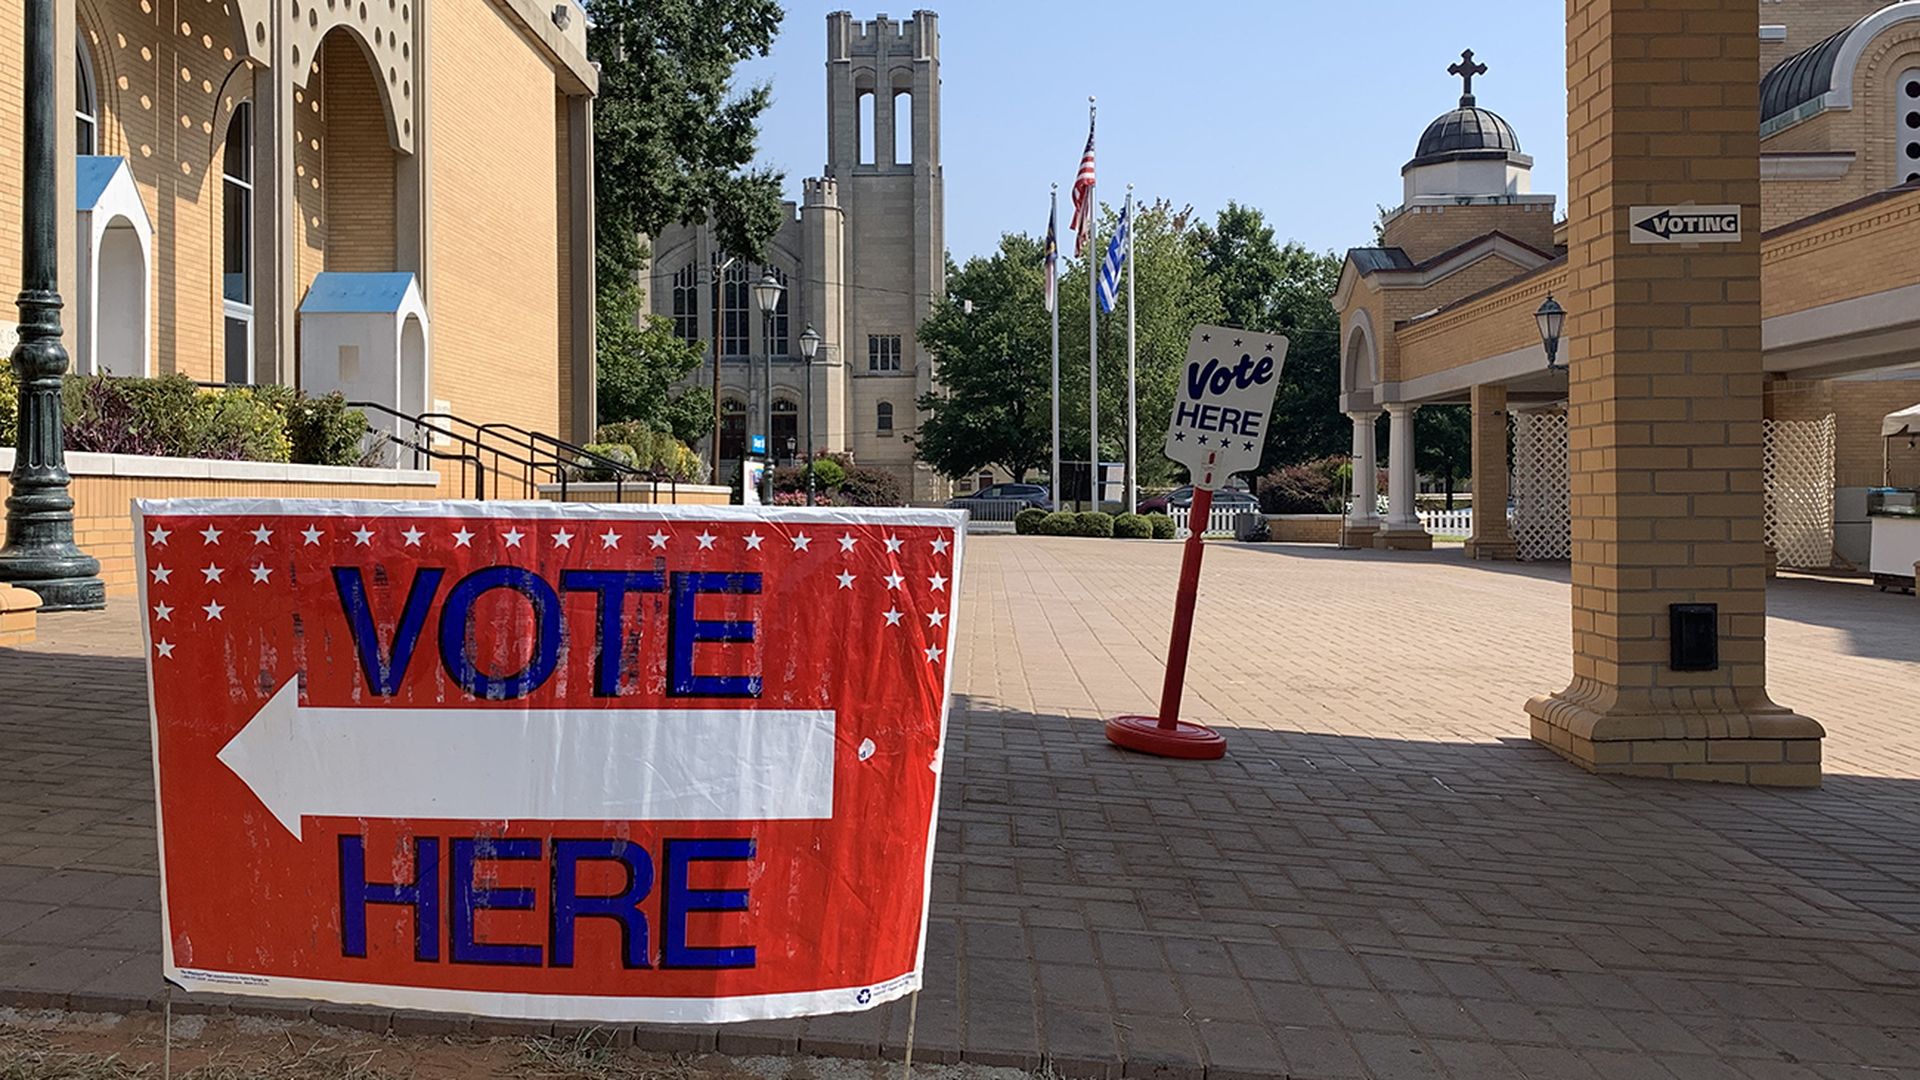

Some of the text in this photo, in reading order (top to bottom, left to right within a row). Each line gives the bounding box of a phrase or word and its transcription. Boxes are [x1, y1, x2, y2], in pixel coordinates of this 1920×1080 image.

[1652, 215, 1736, 233] VOTING
[1187, 353, 1274, 400] Vote
[1175, 401, 1263, 438] HERE
[333, 567, 763, 699] VOTE
[340, 836, 757, 968] HERE
